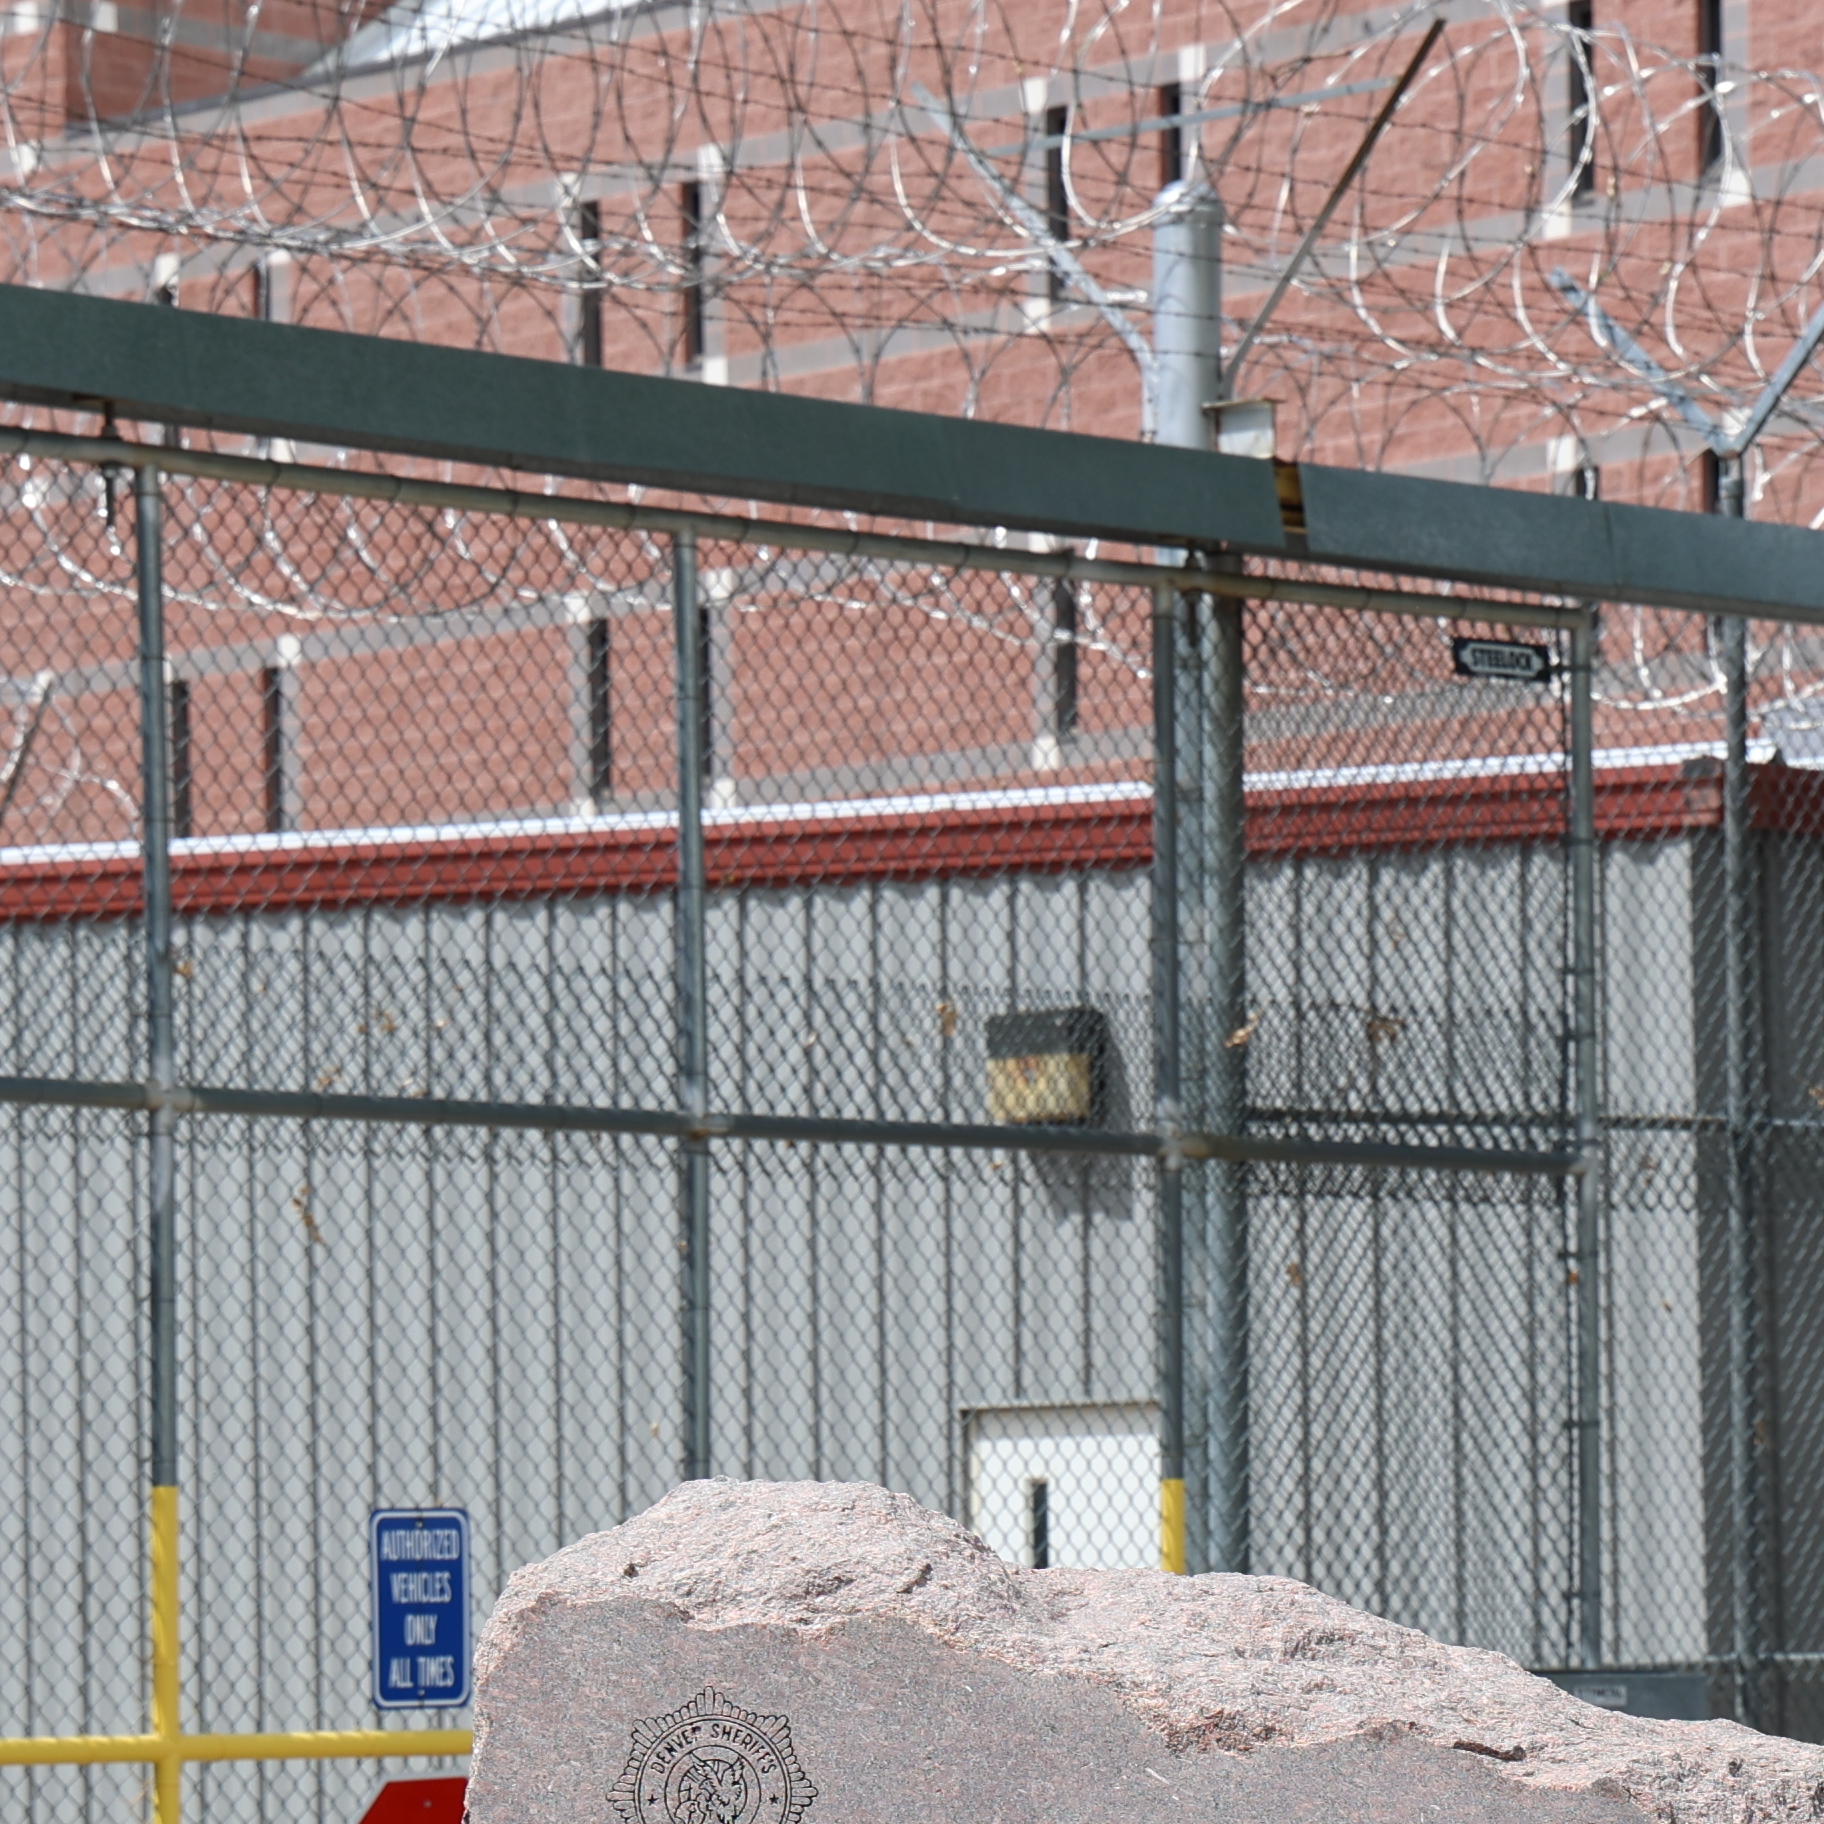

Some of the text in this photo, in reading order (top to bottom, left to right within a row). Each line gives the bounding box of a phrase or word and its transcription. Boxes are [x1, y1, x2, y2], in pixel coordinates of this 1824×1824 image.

[380, 1528, 461, 1561] AUTHORIZED
[389, 1571, 452, 1604] VEHICLES
[404, 1613, 438, 1646] ONLY
[387, 1655, 455, 1689] ALL TIMES
[710, 1722, 778, 1775] SHERIFF'S
